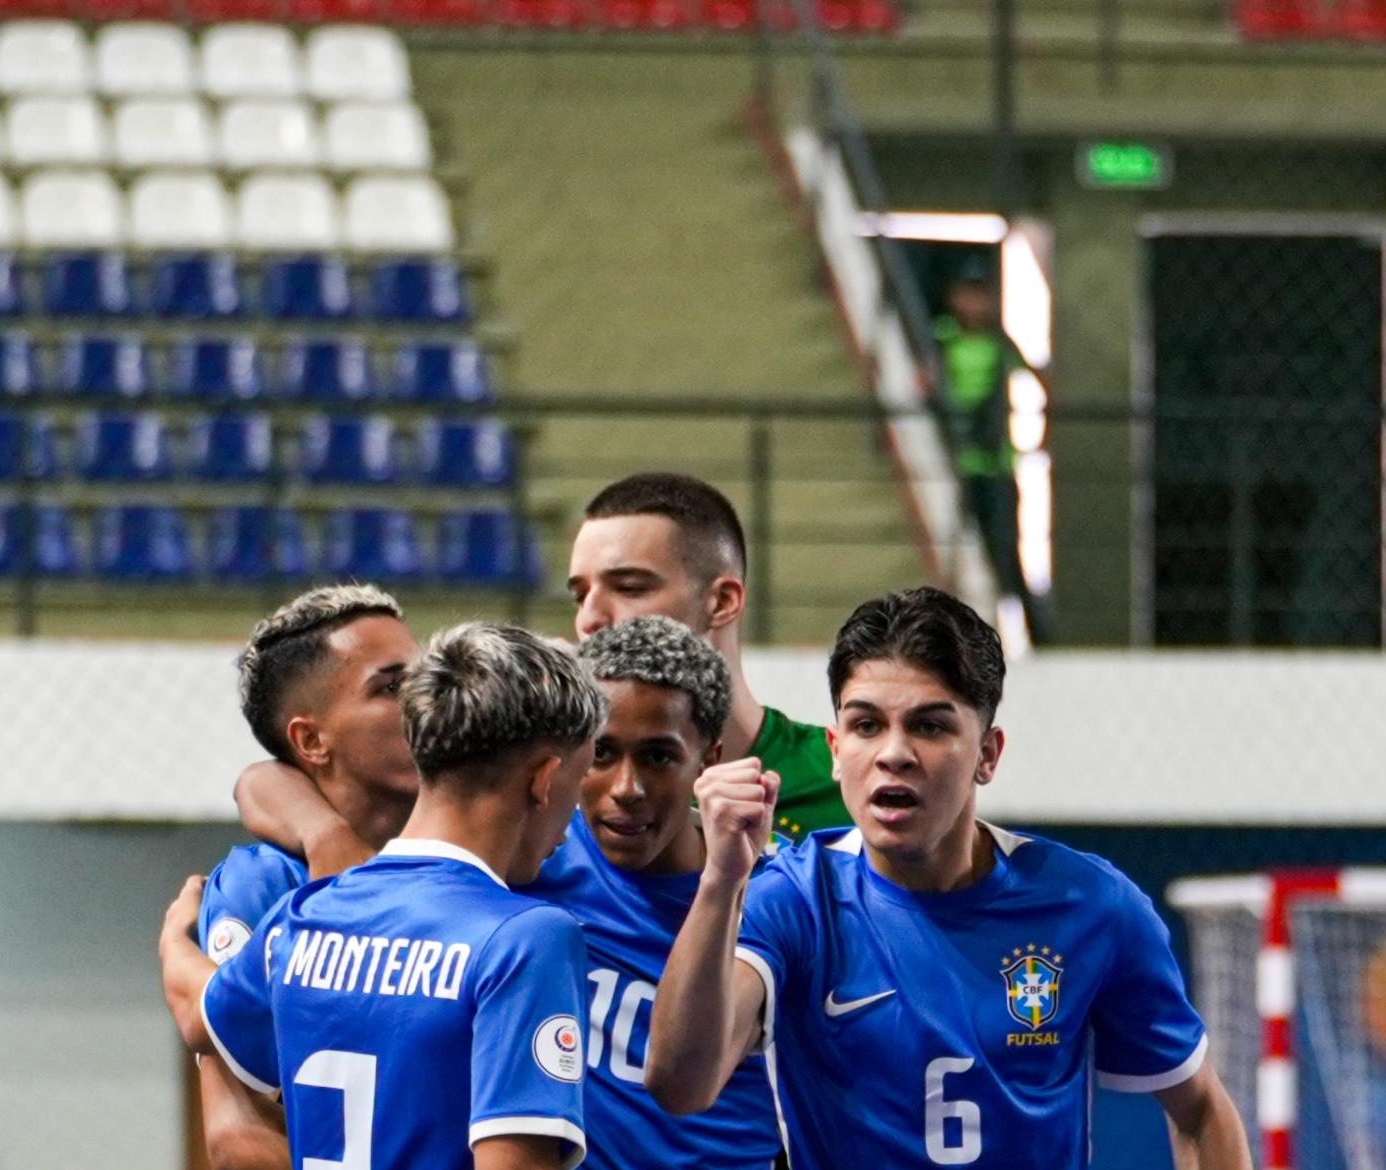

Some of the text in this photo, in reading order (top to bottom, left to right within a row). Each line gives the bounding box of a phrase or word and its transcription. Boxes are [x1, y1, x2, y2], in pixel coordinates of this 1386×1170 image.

[283, 929, 470, 1001] MONTEIRO
[1022, 986, 1043, 995] CBF
[587, 968, 657, 1084] 10
[1007, 1032, 1060, 1046] FUTSAL
[925, 1057, 982, 1165] 6
